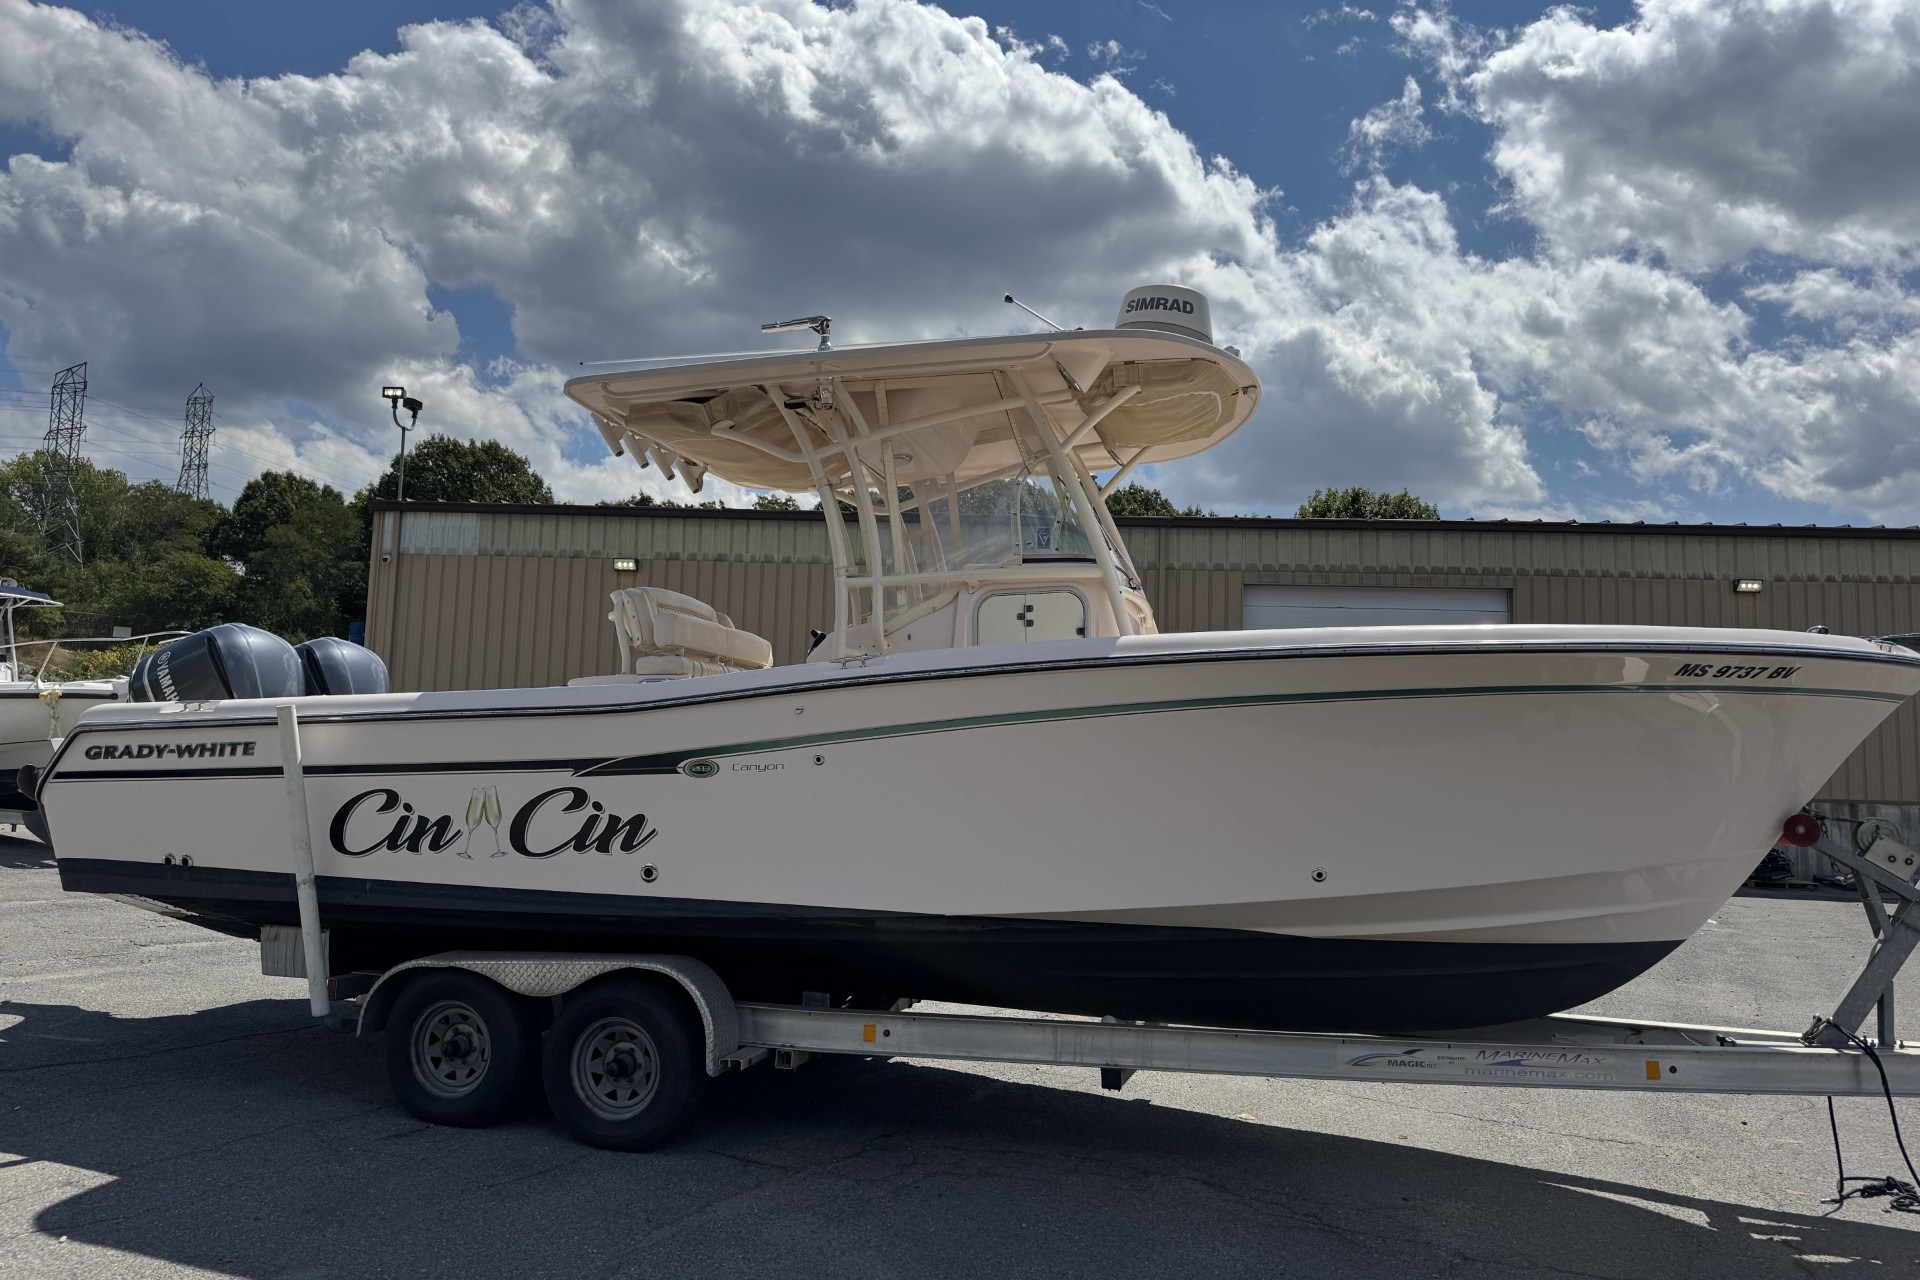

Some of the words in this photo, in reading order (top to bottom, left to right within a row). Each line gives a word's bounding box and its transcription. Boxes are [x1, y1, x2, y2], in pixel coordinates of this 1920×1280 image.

[1125, 296, 1194, 315] SIMRAD
[1674, 663, 1713, 677] MS
[1712, 665, 1769, 679] 9737
[1766, 666, 1802, 679] BV
[156, 660, 180, 703] YAMAH
[84, 740, 257, 760] GRADY-WHITE
[731, 763, 785, 773] Canyon
[329, 788, 463, 858] Cin
[509, 786, 658, 860] Cin
[1387, 1059, 1426, 1068] MAGIC
[1464, 1066, 1614, 1081] marinemax.com
